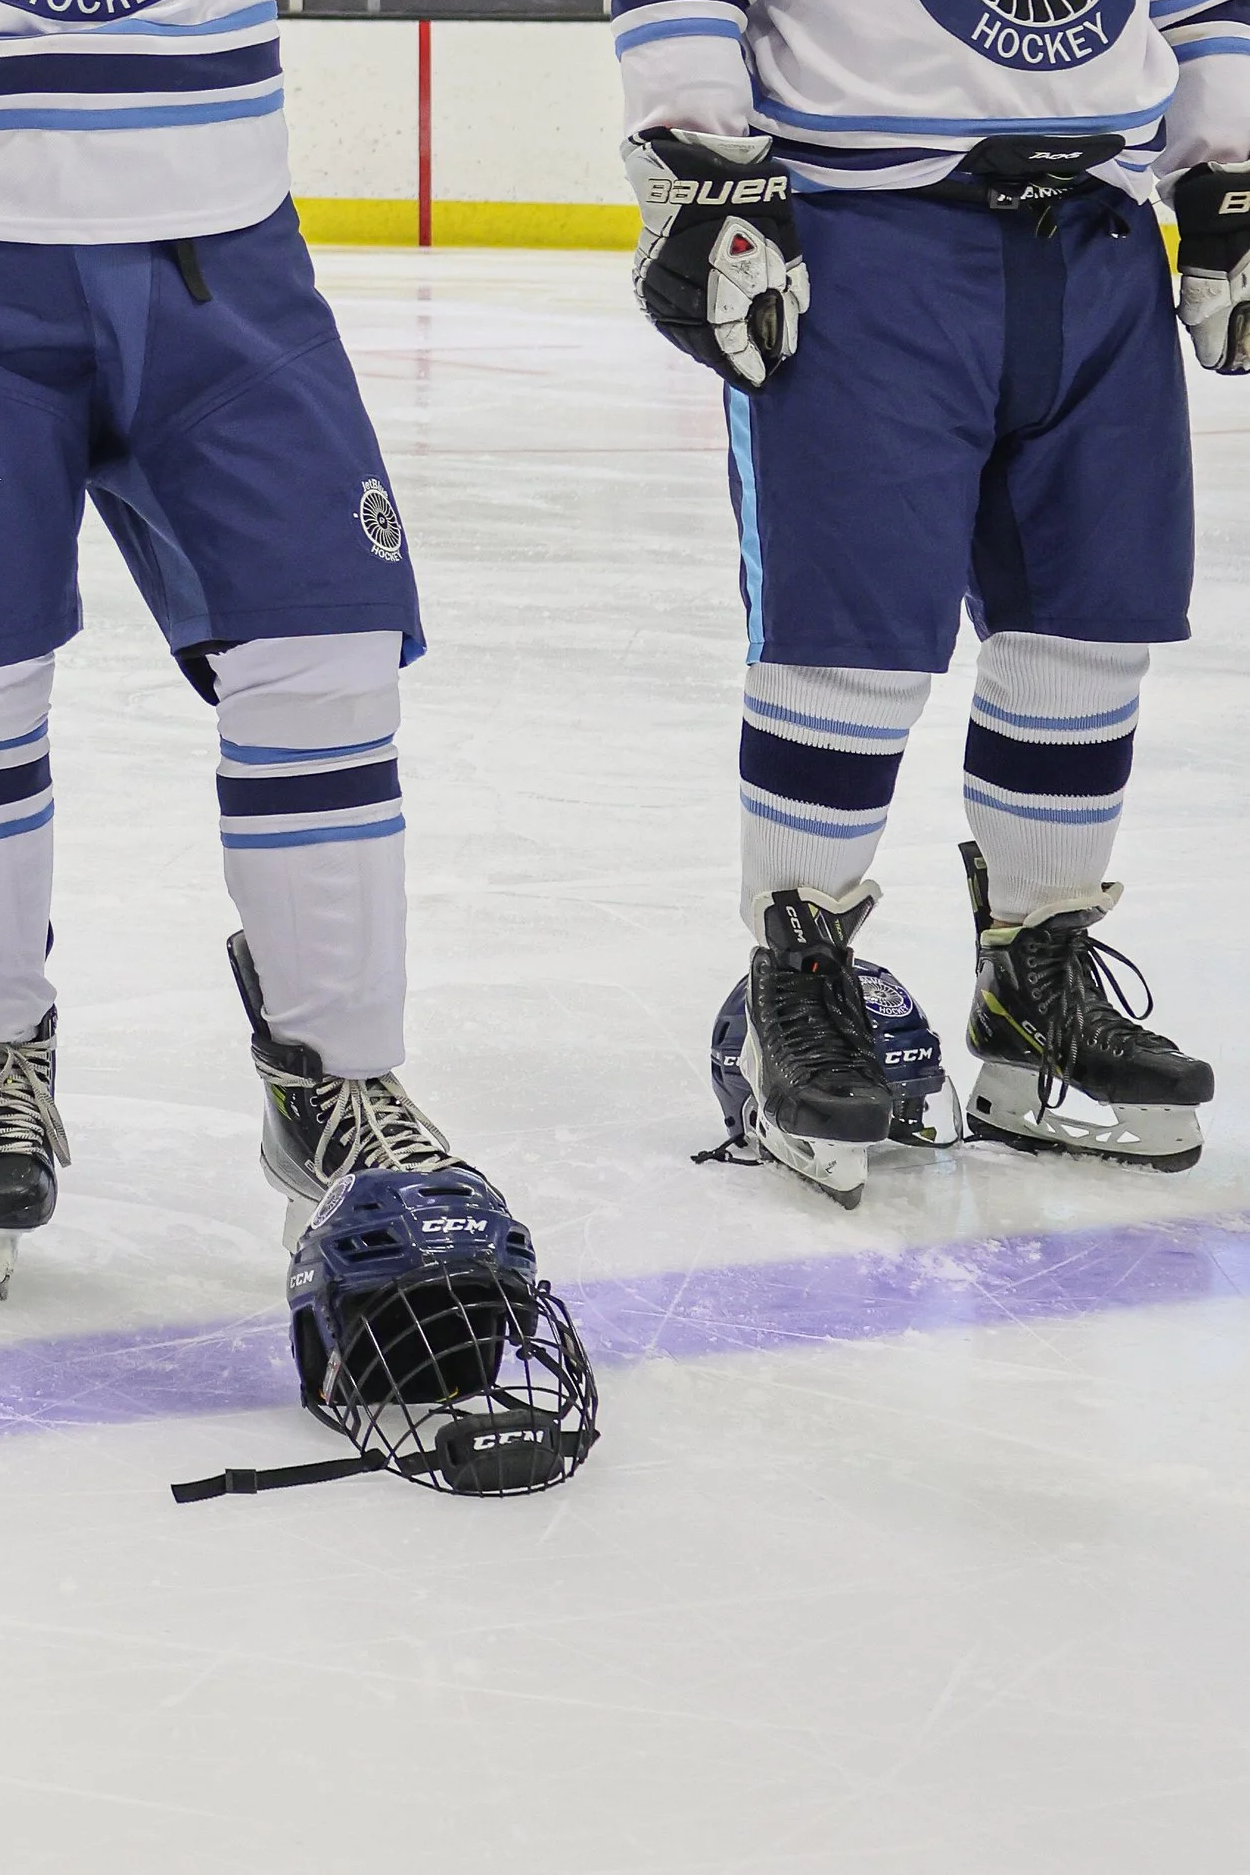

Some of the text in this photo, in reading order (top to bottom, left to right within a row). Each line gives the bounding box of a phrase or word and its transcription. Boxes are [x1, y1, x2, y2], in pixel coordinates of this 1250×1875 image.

[972, 13, 1110, 64] HOCKEY
[786, 905, 807, 944] CCM
[878, 1005, 909, 1015] HOCKEY
[1021, 1020, 1047, 1046] CC
[884, 1047, 933, 1064] CCM
[421, 1216, 488, 1234] CCM
[290, 1269, 315, 1289] CCM
